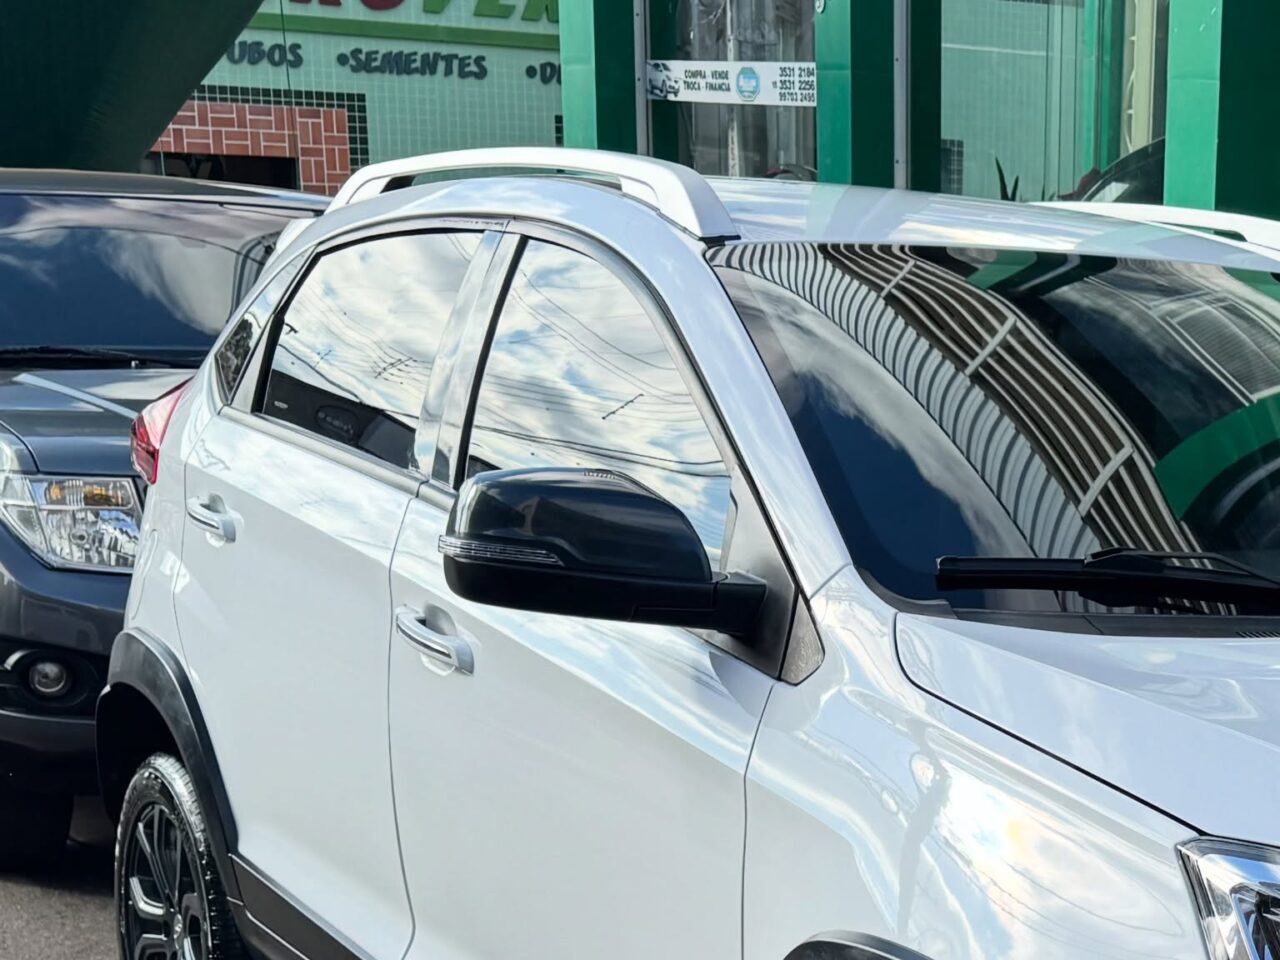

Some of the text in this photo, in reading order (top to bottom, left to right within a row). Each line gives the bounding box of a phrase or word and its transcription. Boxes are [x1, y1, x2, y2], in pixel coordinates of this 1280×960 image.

[349, 48, 488, 80] SEMENTES
[684, 69, 729, 80] COMPRA VENDE
[779, 66, 815, 78] 3531 2184
[683, 80, 731, 92] TROCA FINANCIA
[779, 79, 795, 90] 3531
[798, 79, 815, 91] 2256
